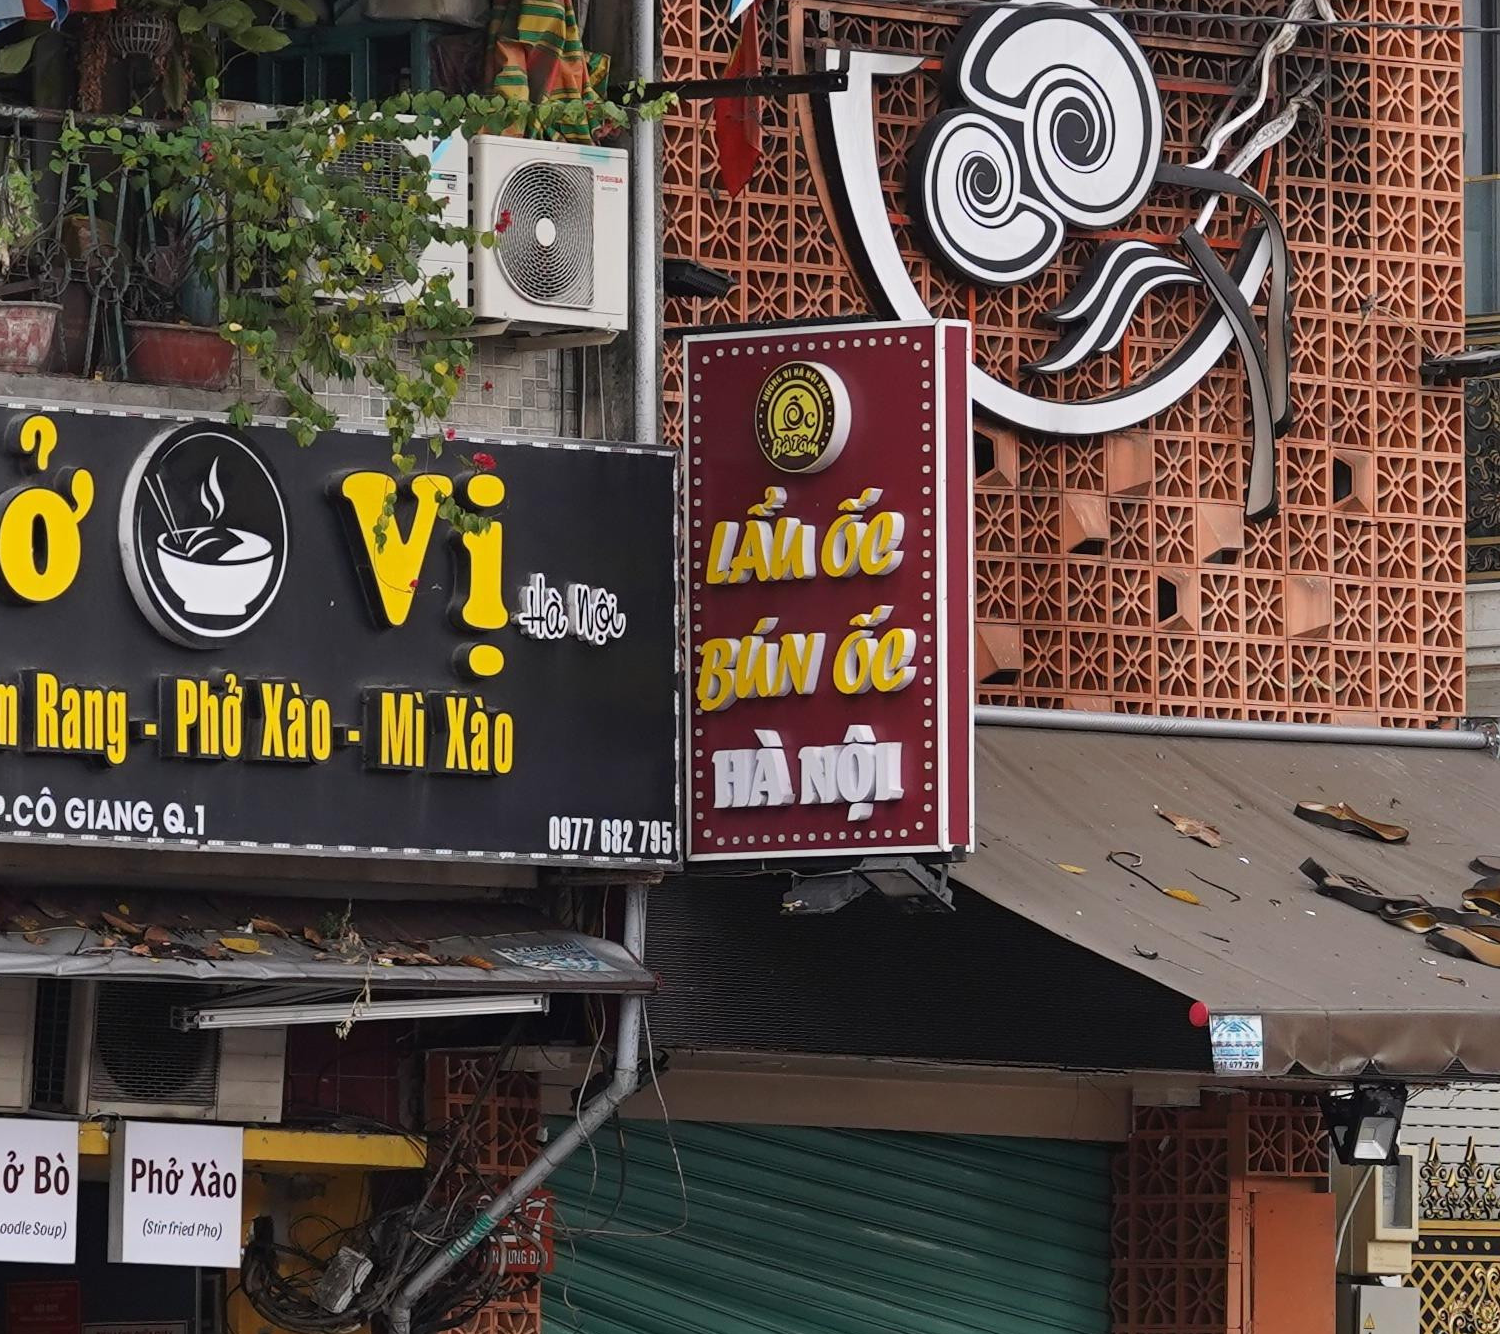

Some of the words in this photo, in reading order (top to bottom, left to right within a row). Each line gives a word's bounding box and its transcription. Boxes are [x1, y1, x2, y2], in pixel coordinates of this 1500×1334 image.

[821, 487, 904, 578] ỐC
[340, 470, 509, 677] Vị
[518, 573, 568, 640] Hà
[572, 584, 626, 646] Nội
[698, 616, 826, 712] BÚN
[833, 605, 917, 696] ỐC
[37, 671, 127, 767] Rang
[176, 669, 243, 760] Phở
[262, 682, 333, 761] Xào
[380, 684, 426, 770] Mì
[445, 682, 514, 774] Xào
[712, 729, 795, 809] HÀ
[800, 724, 903, 822] NỘI
[64, 795, 157, 839] GIANG,
[162, 801, 206, 838] Q.1
[548, 815, 594, 851] 0977
[600, 818, 633, 853] 682
[639, 821, 674, 856] 795
[34, 1152, 71, 1196] Bò
[130, 1157, 183, 1196] Phở
[190, 1160, 238, 1199] Xào
[33, 1220, 67, 1242] Soup)
[142, 1218, 169, 1238] (Stir
[169, 1219, 195, 1238] fried
[197, 1220, 223, 1241] Pho)
